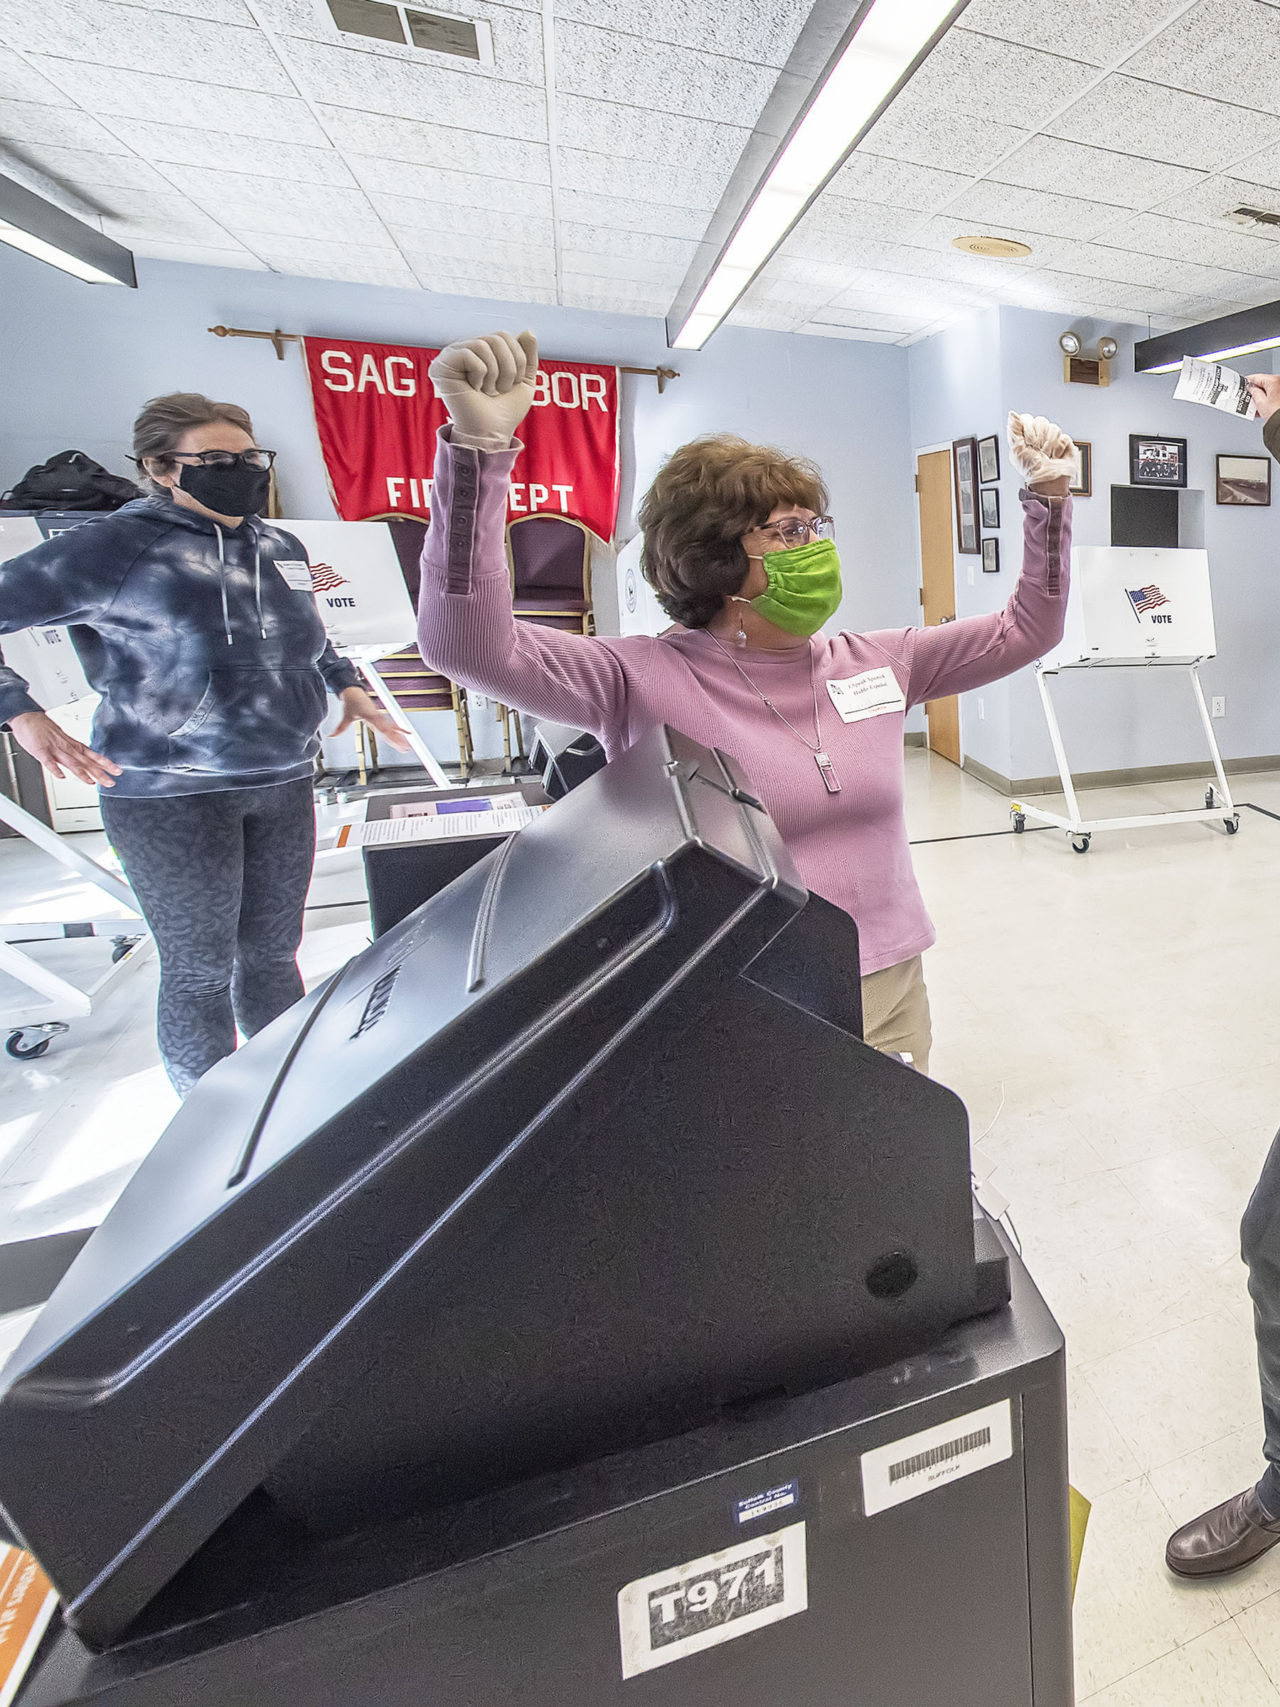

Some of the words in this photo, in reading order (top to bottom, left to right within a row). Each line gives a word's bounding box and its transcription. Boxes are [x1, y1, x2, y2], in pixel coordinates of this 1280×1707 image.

[320, 350, 417, 397] SAG
[508, 483, 573, 513] EPT
[326, 597, 356, 608] VOTE
[1151, 614, 1172, 624] VOTE
[650, 1551, 776, 1624] T971
